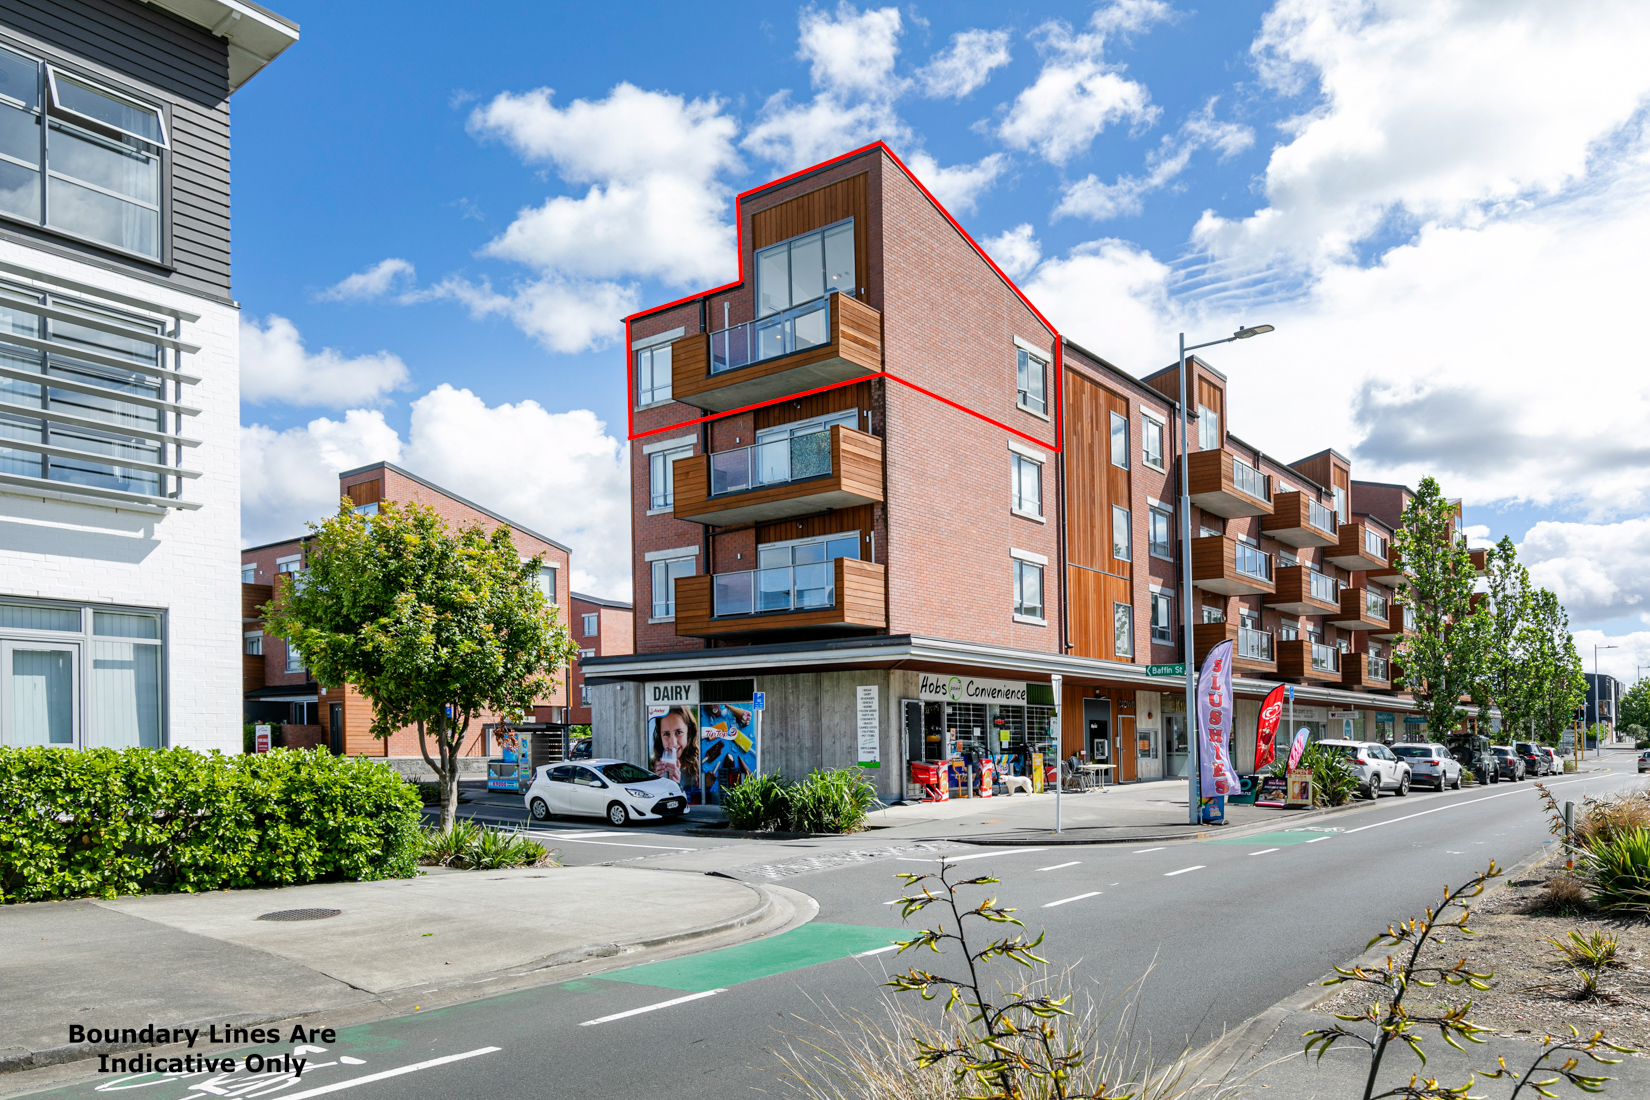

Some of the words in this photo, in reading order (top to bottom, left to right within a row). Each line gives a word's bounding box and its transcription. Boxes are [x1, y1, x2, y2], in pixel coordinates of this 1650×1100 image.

[1152, 666, 1172, 674] Baffin
[1175, 666, 1183, 674] St
[653, 685, 691, 701] DAIRY
[920, 675, 947, 695] Hobs
[966, 680, 1026, 700] Convenience
[1208, 658, 1230, 794] SLUSHIES
